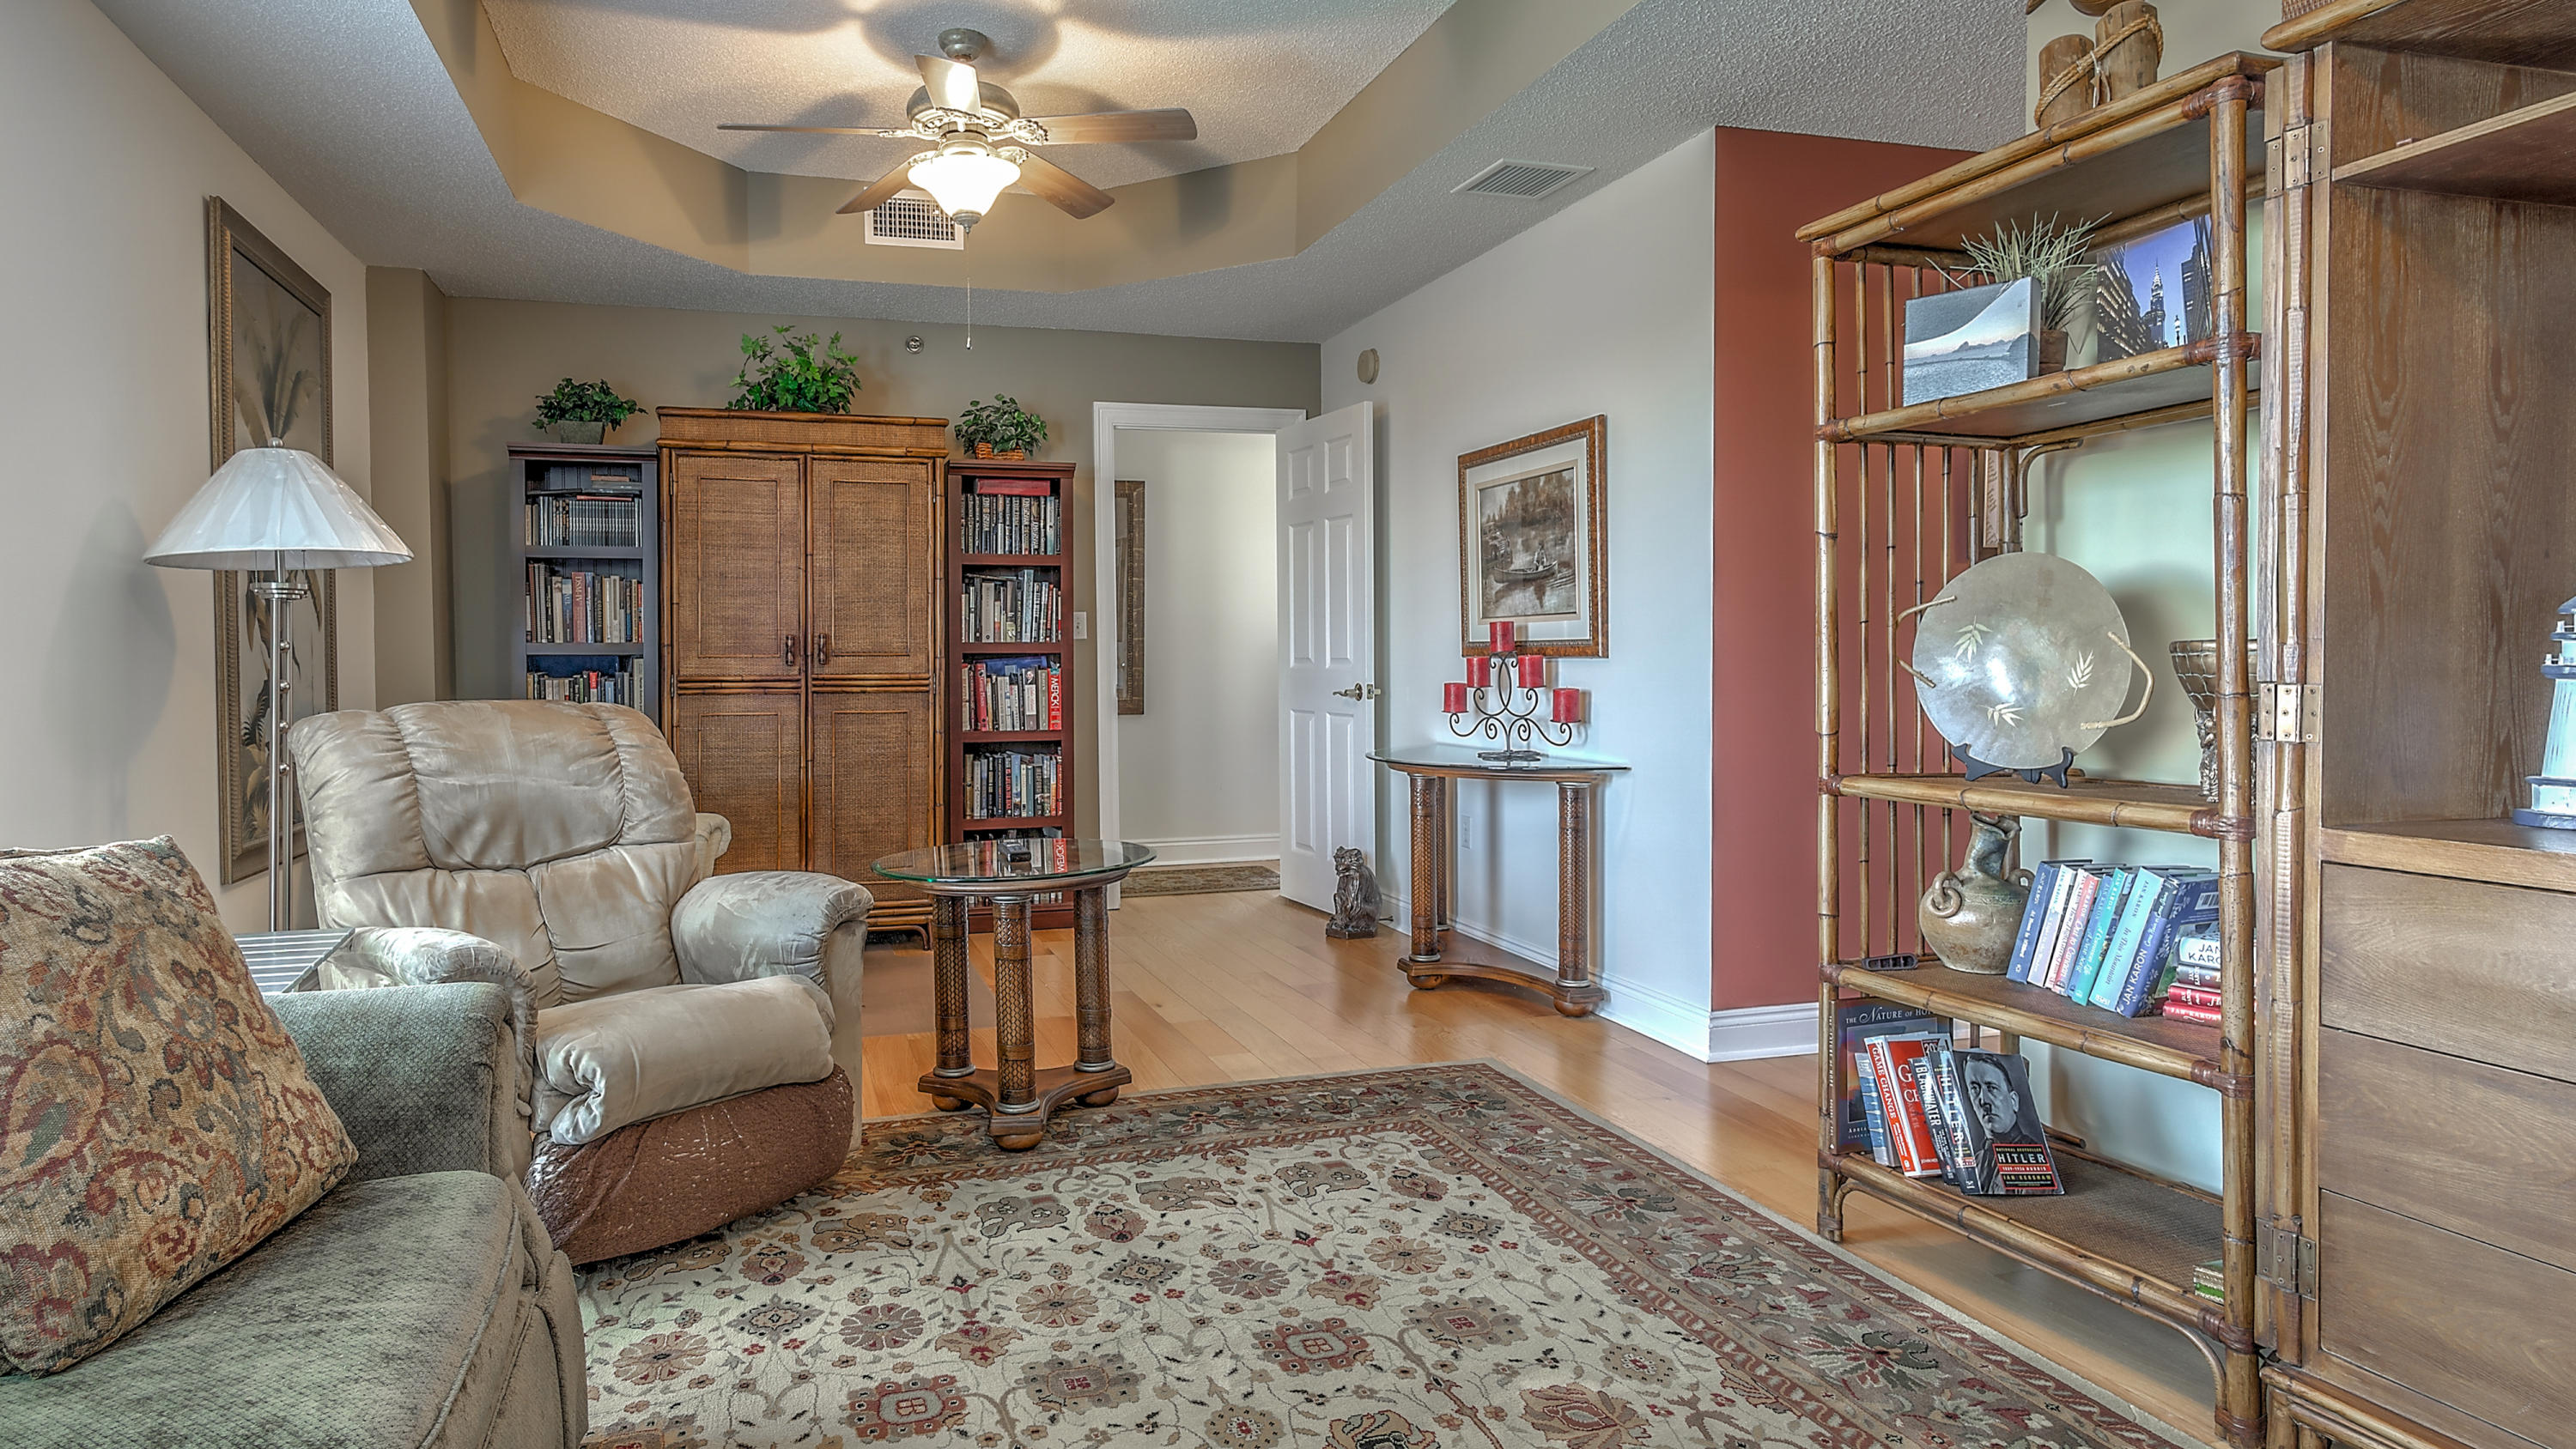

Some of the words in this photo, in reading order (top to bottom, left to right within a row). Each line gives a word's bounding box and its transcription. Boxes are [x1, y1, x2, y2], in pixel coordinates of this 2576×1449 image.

[1050, 677, 1060, 706] MERCK
[2081, 893, 2090, 918] KARON
[2108, 886, 2117, 910] KARON
[2133, 894, 2143, 918] KARON
[2073, 919, 2083, 937] Out
[2117, 936, 2128, 953] This
[2061, 945, 2075, 977] Canaan
[2105, 953, 2121, 985] Mountain
[2189, 953, 2221, 963] KARO
[2122, 983, 2135, 1005] JAN
[2129, 948, 2147, 985] KARON
[1860, 1006, 1903, 1024] NATURE
[1872, 1047, 1885, 1076] GAME
[1880, 1077, 1897, 1119] CHANGE
[1940, 1076, 1964, 1145] HITLER
[1997, 1153, 2046, 1163] HITLER
